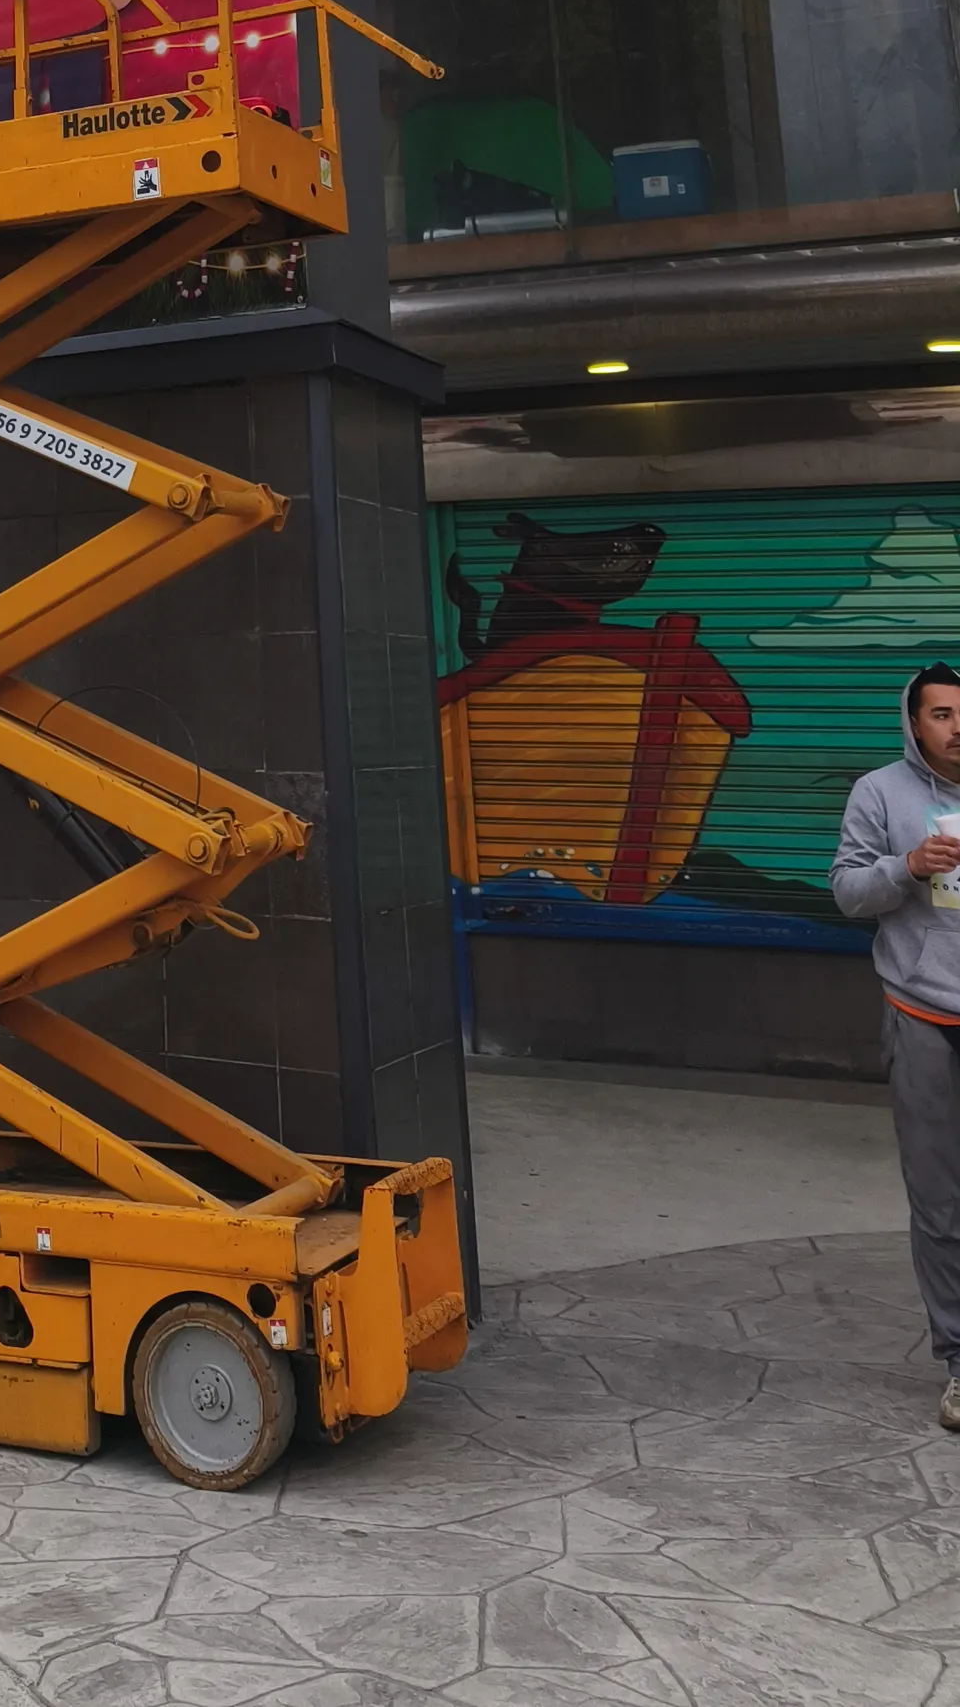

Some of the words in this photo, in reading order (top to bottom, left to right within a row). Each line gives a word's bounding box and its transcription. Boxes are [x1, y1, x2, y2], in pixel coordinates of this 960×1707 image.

[62, 102, 166, 139] Haulotte
[19, 423, 31, 439] 9
[33, 428, 78, 460] 7205
[79, 448, 126, 479] 3827
